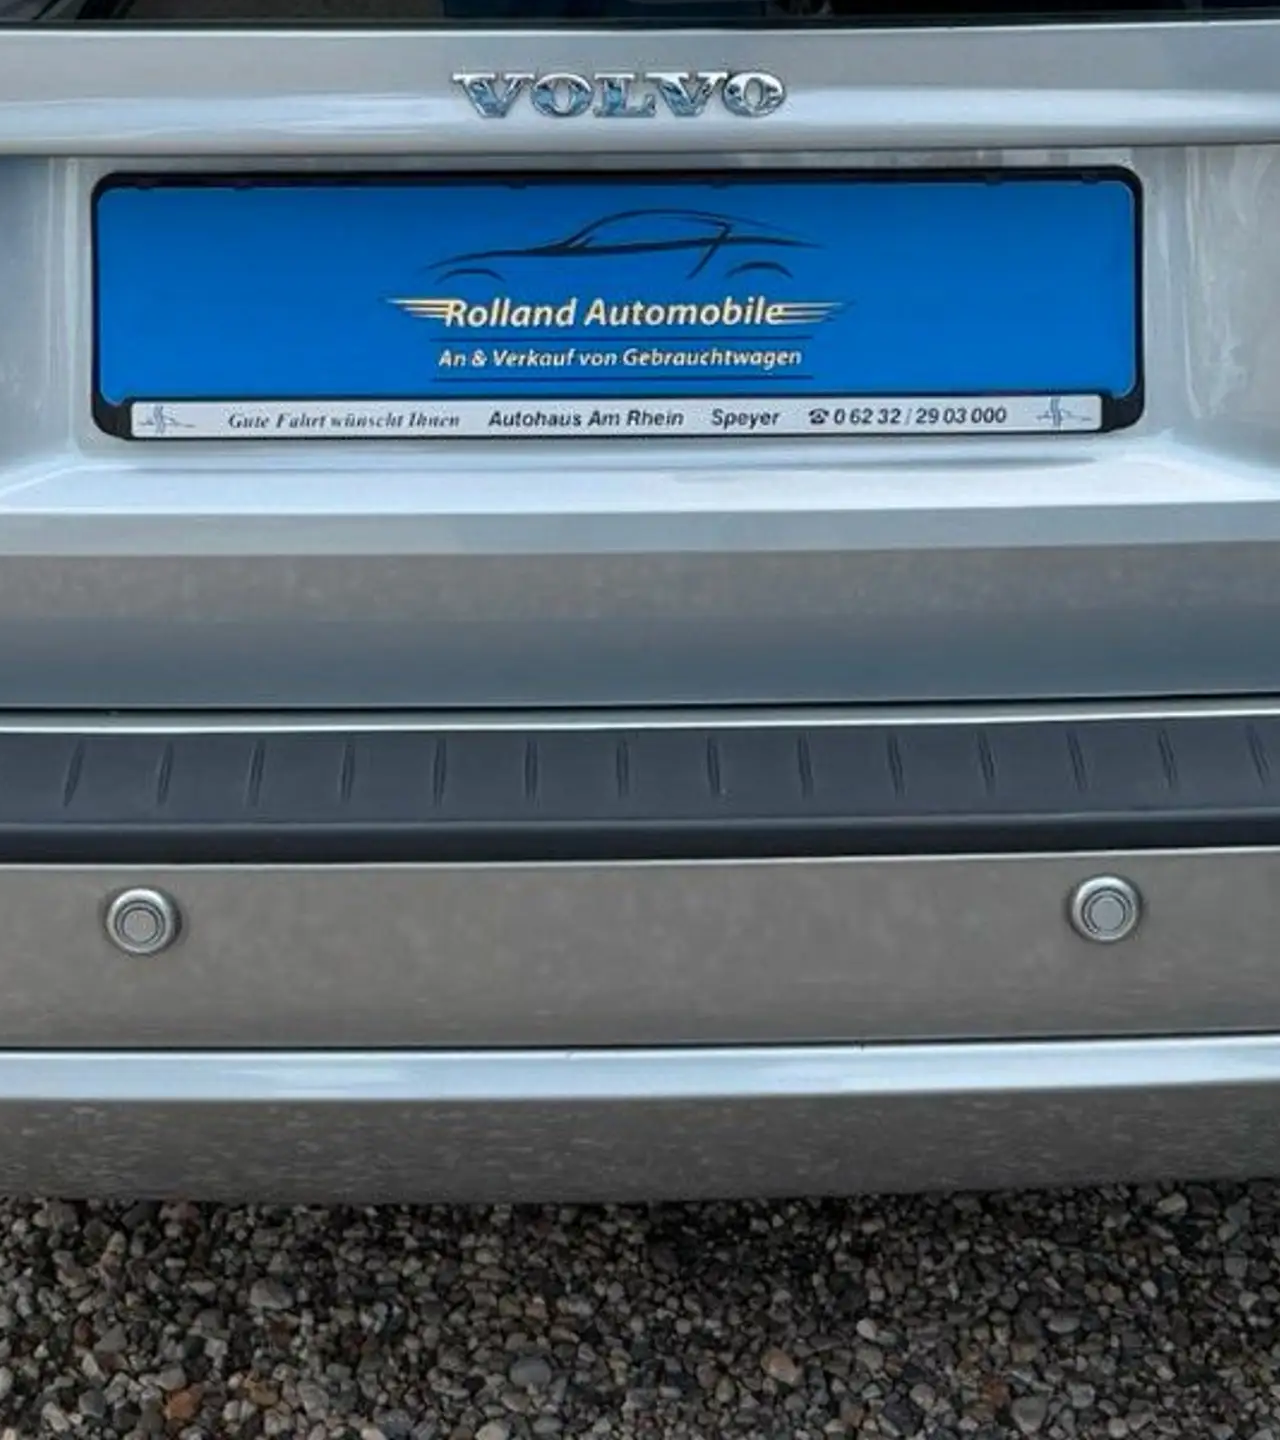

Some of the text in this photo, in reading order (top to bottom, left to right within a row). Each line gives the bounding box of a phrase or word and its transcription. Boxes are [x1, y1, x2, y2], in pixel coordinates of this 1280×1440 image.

[451, 70, 787, 119] VOLVO
[445, 295, 786, 328] Rolland Automobile
[438, 346, 803, 371] An & Verkauf von Gebrauchtwagen
[227, 412, 270, 429] Gute
[275, 412, 327, 429] Fahrt
[330, 411, 403, 429] wünscht
[408, 411, 460, 429] Ihnen
[488, 410, 582, 428] Autohaus
[587, 410, 621, 427] Am
[625, 409, 685, 427] Rhein
[711, 409, 781, 430] Speyer
